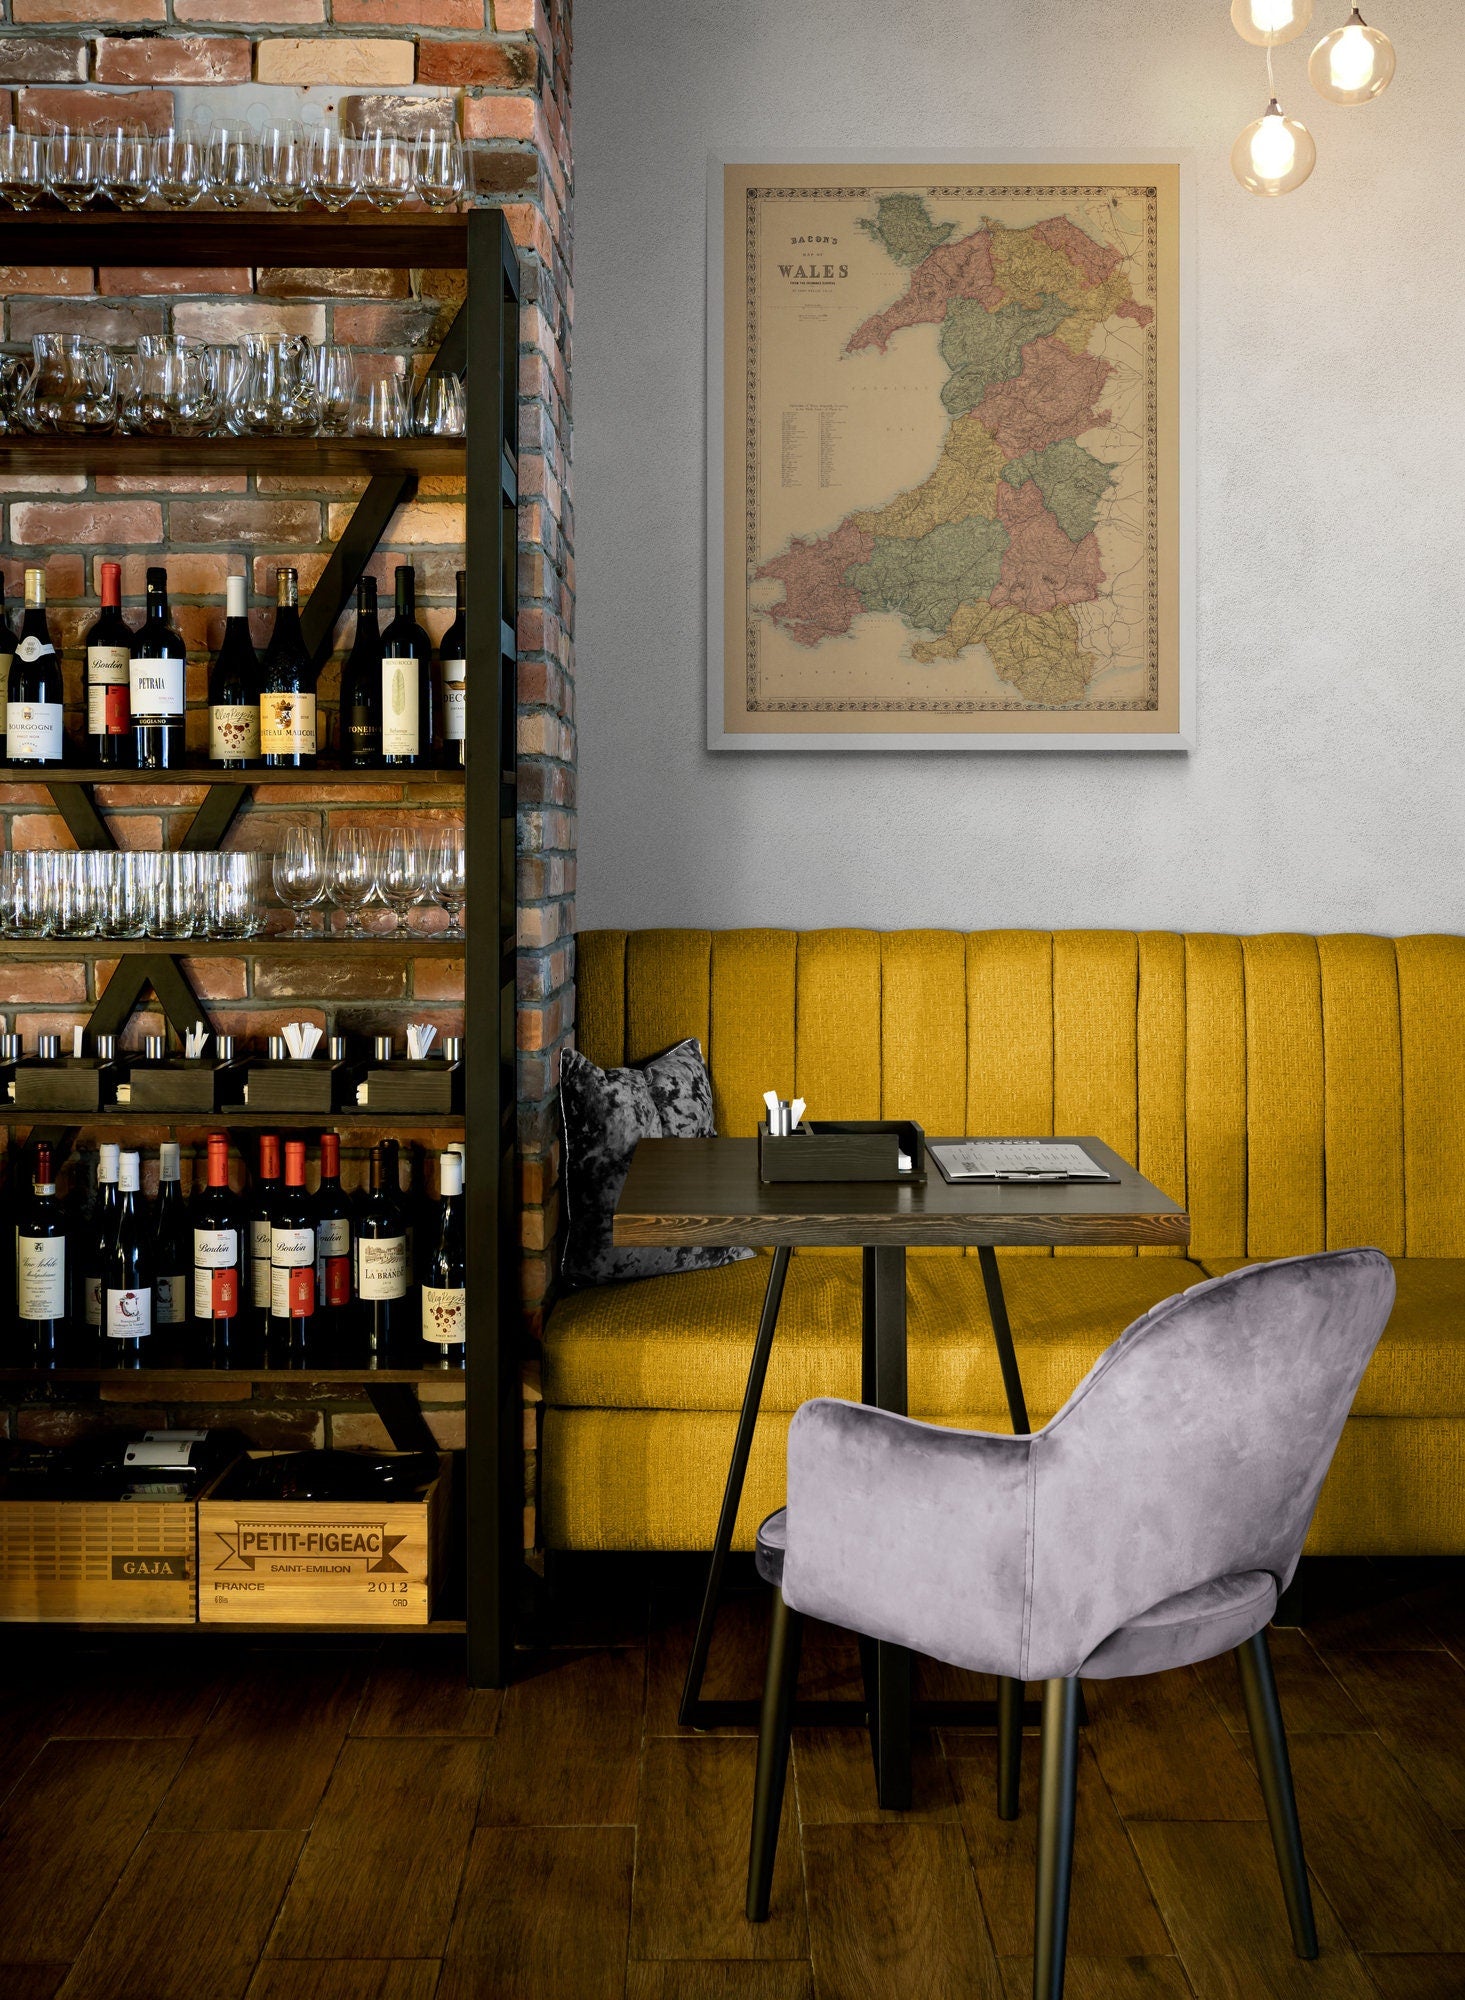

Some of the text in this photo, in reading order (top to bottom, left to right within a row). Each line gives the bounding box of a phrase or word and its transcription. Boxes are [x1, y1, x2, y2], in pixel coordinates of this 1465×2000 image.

[791, 235, 838, 245] BACON'S
[777, 264, 848, 279] WALES
[138, 677, 165, 690] PETRAIA
[9, 723, 53, 731] BOURGOGNE
[320, 1232, 344, 1242] ordón
[199, 1242, 230, 1253] Bordón
[276, 1242, 307, 1252] Bordón
[242, 1532, 380, 1553] PETIT-FIGEAC
[123, 1562, 174, 1575] GAJA
[270, 1564, 351, 1573] SAINT-EMILION
[214, 1582, 265, 1591] FRANCE
[367, 1581, 408, 1593] 2012
